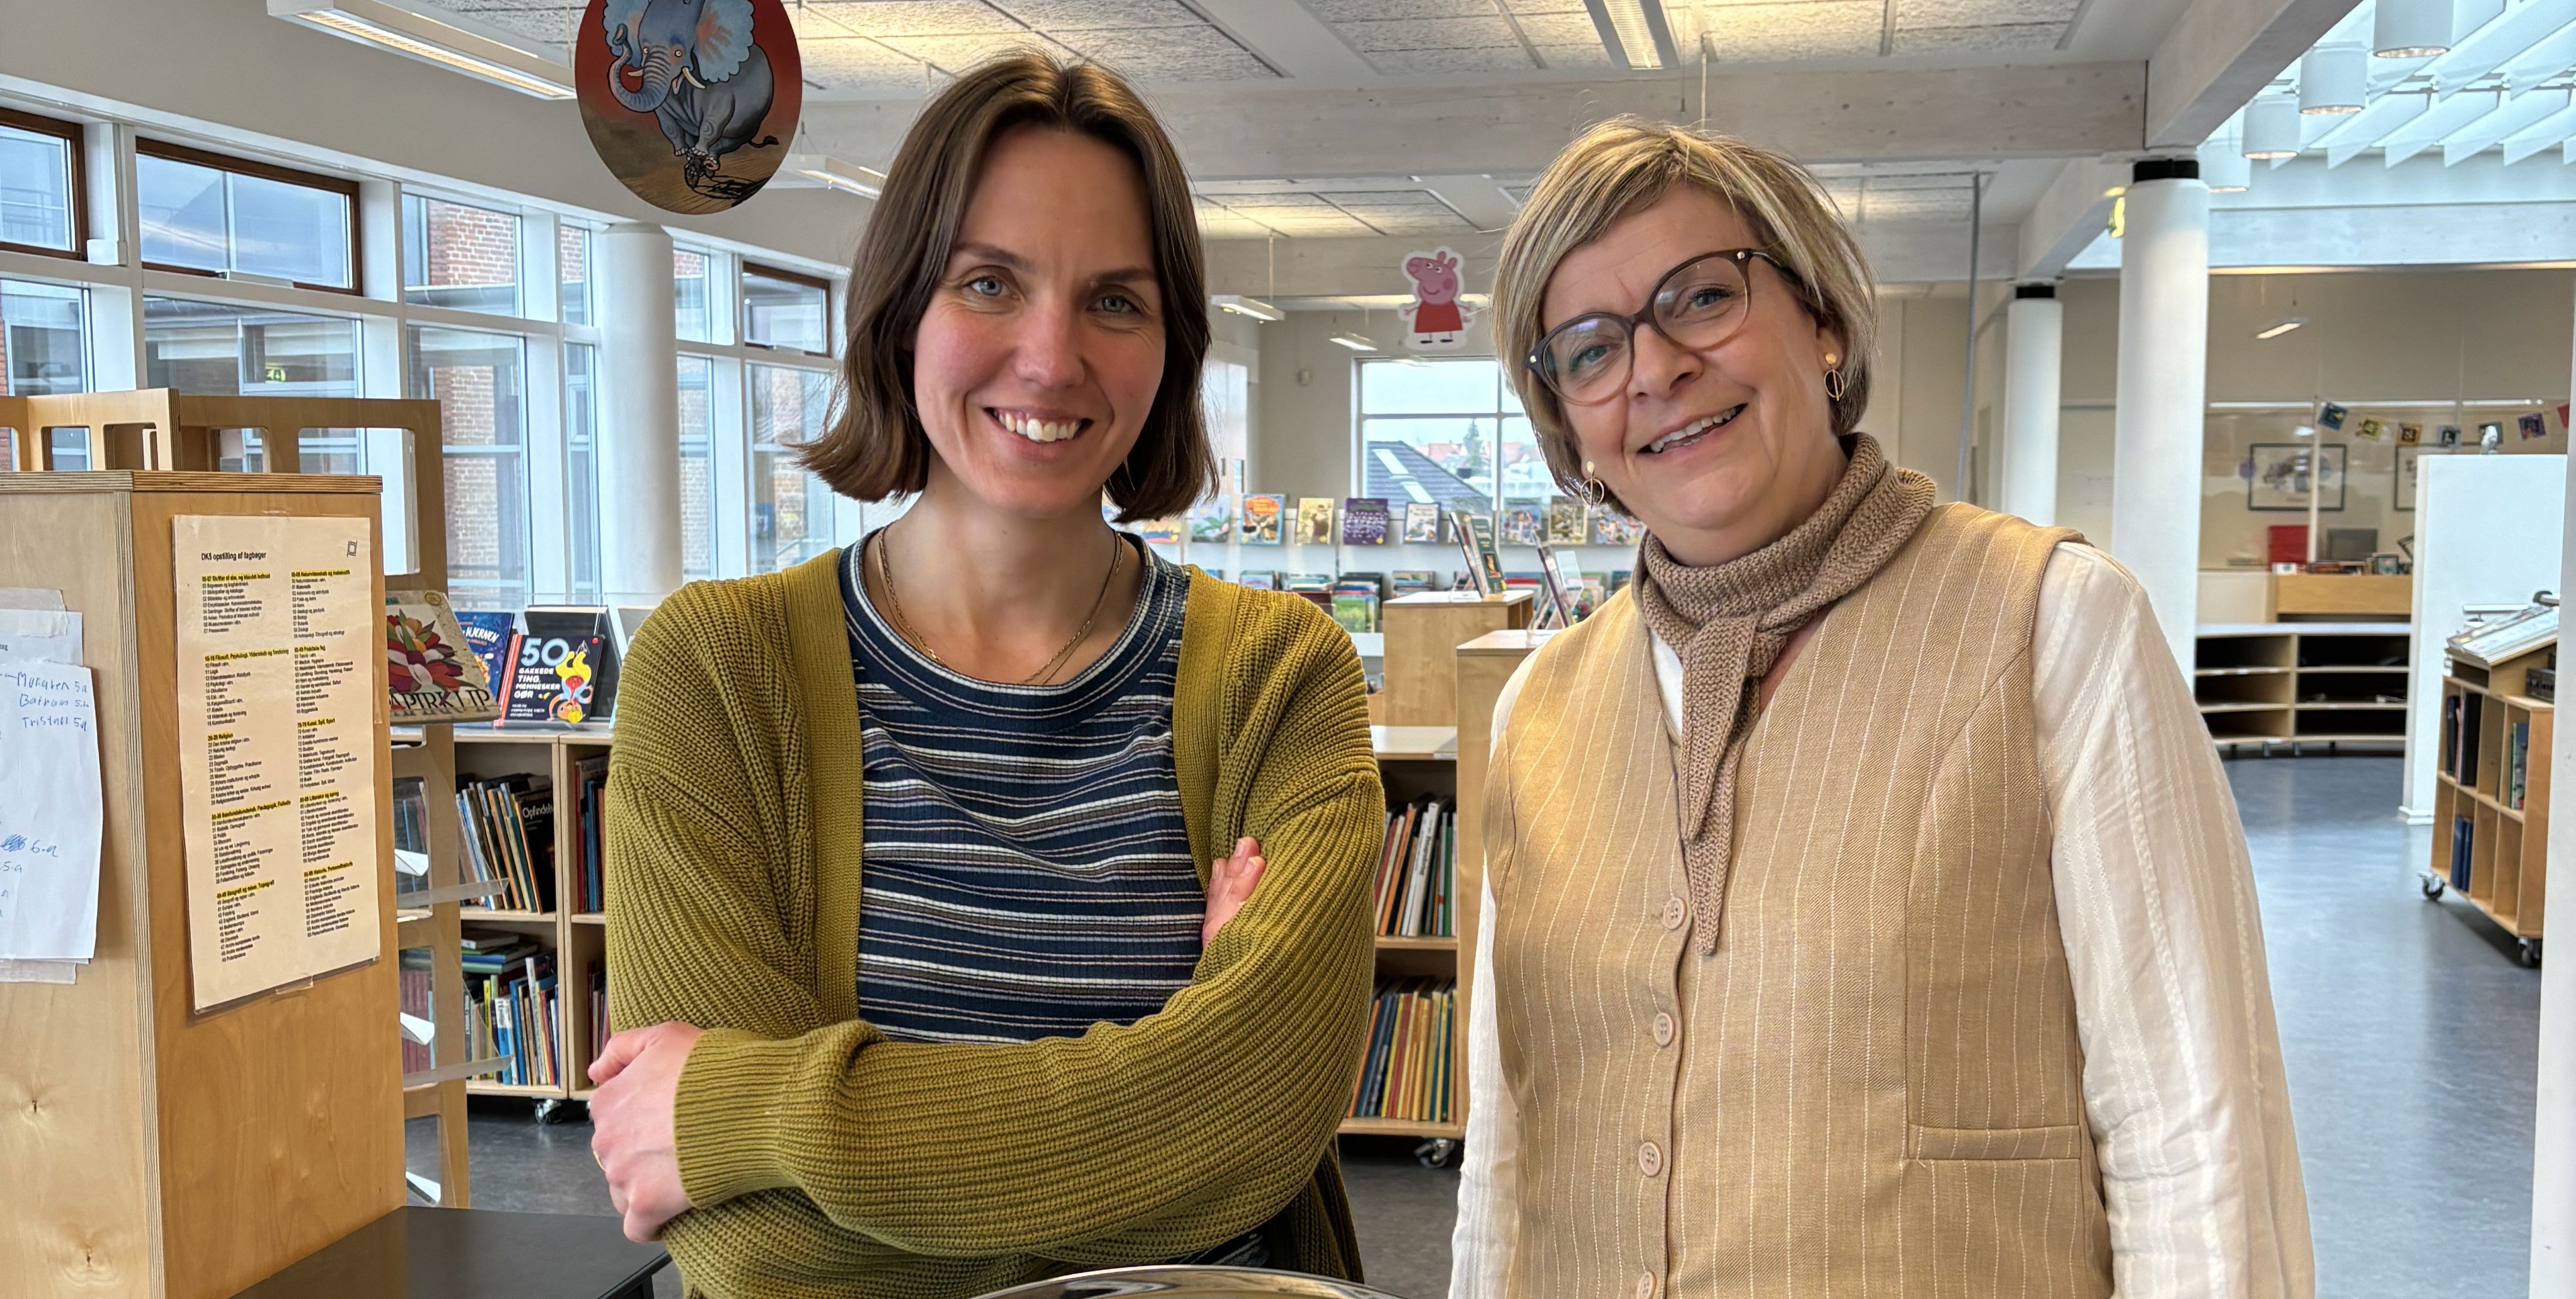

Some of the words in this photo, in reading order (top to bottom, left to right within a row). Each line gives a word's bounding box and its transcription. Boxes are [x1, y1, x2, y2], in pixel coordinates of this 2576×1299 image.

[213, 552, 236, 561] opstilling
[465, 627, 500, 643] HJERNEN
[521, 637, 570, 666] 50
[514, 690, 534, 699] GØR
